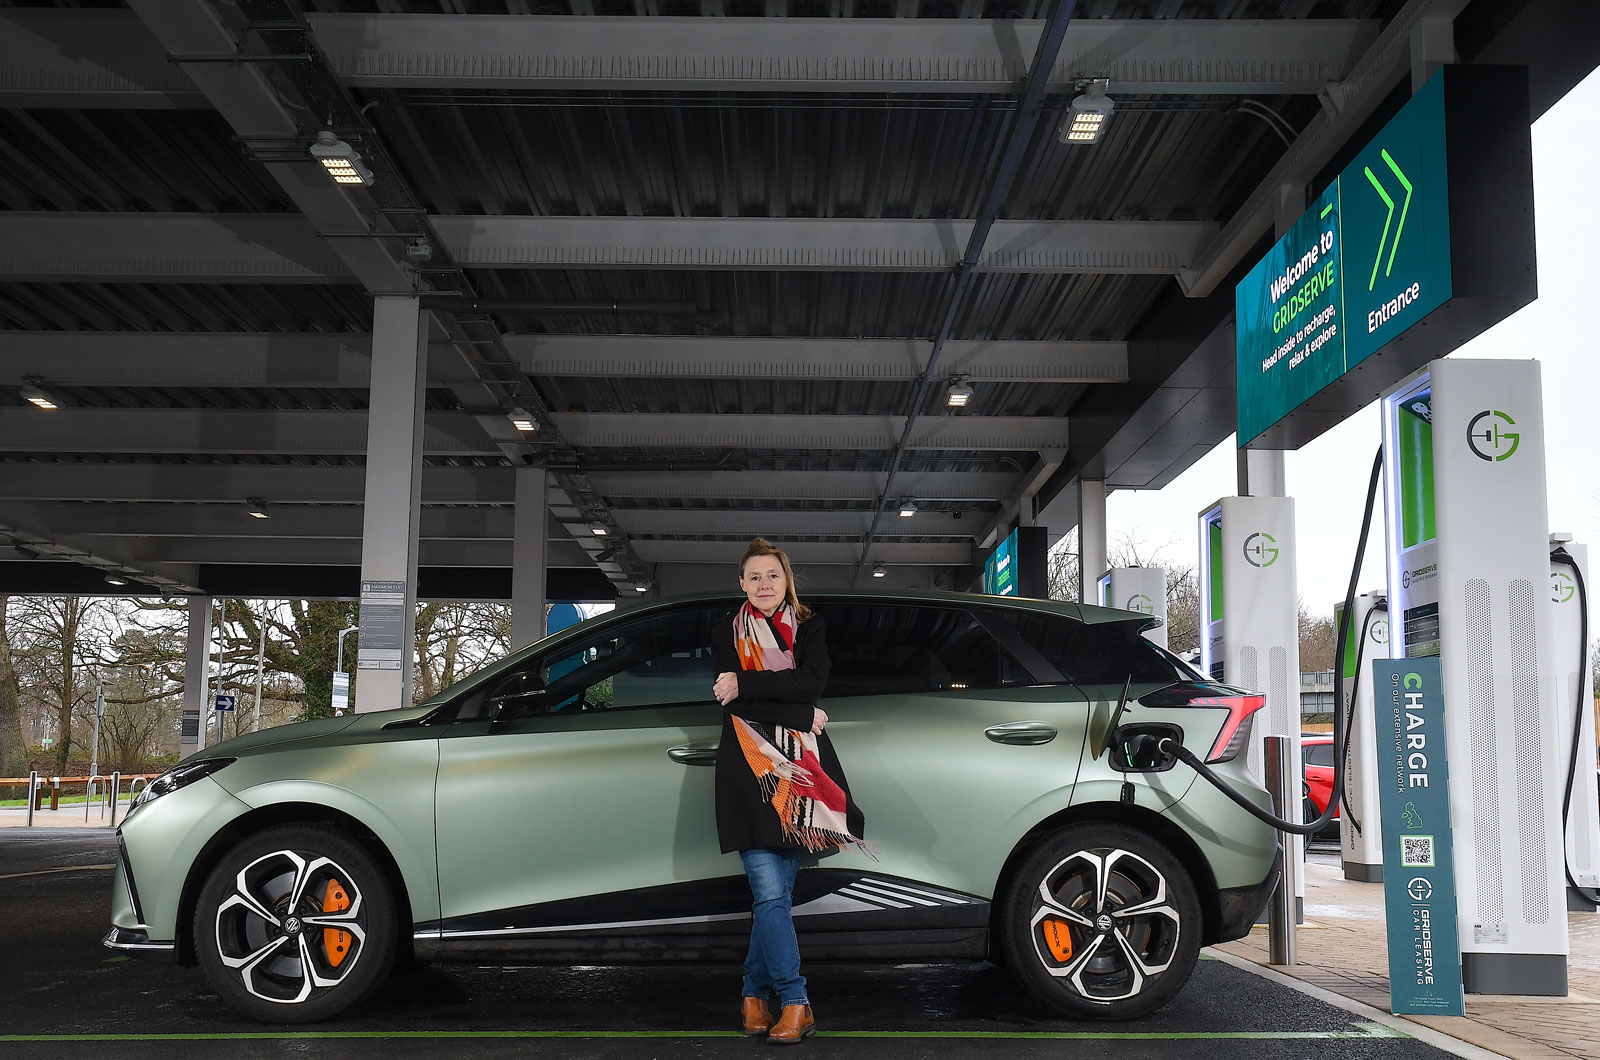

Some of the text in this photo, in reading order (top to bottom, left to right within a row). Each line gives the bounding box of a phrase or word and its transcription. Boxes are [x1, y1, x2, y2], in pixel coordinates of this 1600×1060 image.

[1270, 230, 1333, 303] Welcome to
[1273, 260, 1335, 334] GRIDSERVE
[1262, 304, 1336, 373] Head inside to recharge,
[1368, 282, 1419, 333] Entrance
[1289, 324, 1337, 371] relax & explore
[1391, 673, 1406, 793] On our extensive network
[1403, 672, 1429, 788] CHARGE
[1412, 909, 1424, 985] CAR LEASING
[1421, 909, 1434, 985] GRIDSERVE
